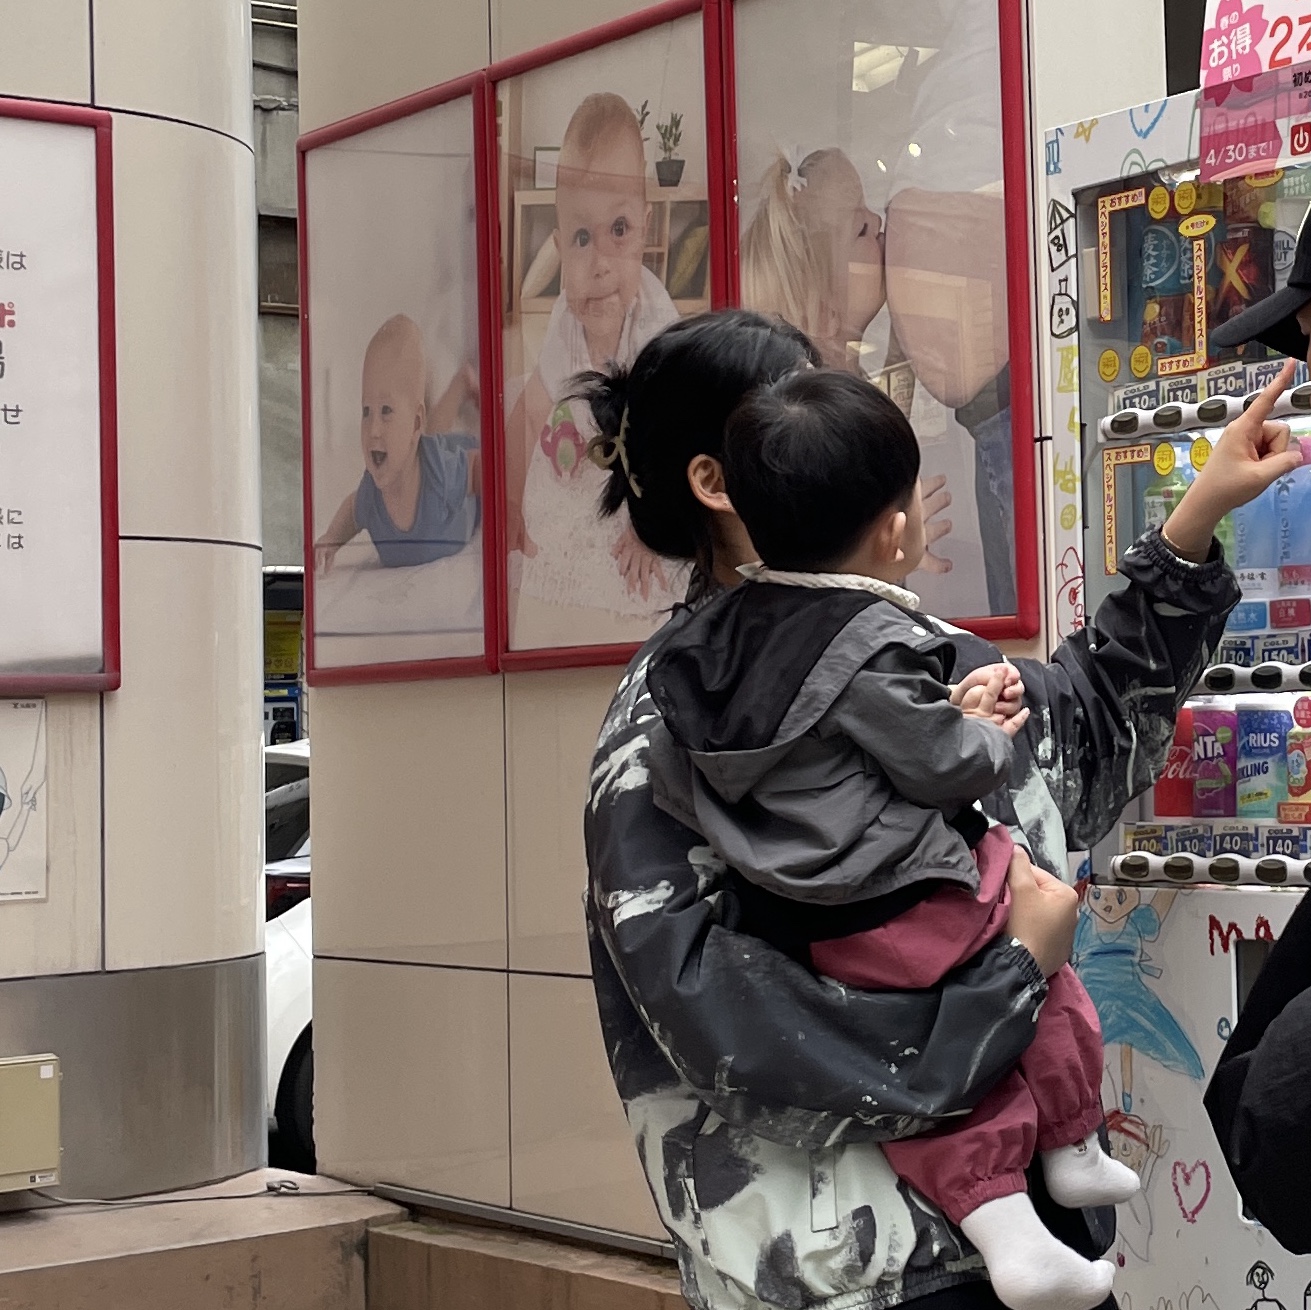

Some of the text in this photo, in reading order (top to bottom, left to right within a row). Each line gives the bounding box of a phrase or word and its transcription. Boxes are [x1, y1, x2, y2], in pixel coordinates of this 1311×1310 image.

[1208, 23, 1253, 67] お得
[1207, 365, 1236, 377] COLD
[1169, 378, 1192, 388] COLD
[1123, 384, 1150, 396] COLD
[0, 507, 24, 526] に
[1222, 639, 1247, 647] COLD
[1264, 639, 1289, 647] COLD
[1133, 828, 1158, 837] COLD
[1176, 828, 1199, 837] COLD
[1267, 828, 1294, 836] COLD
